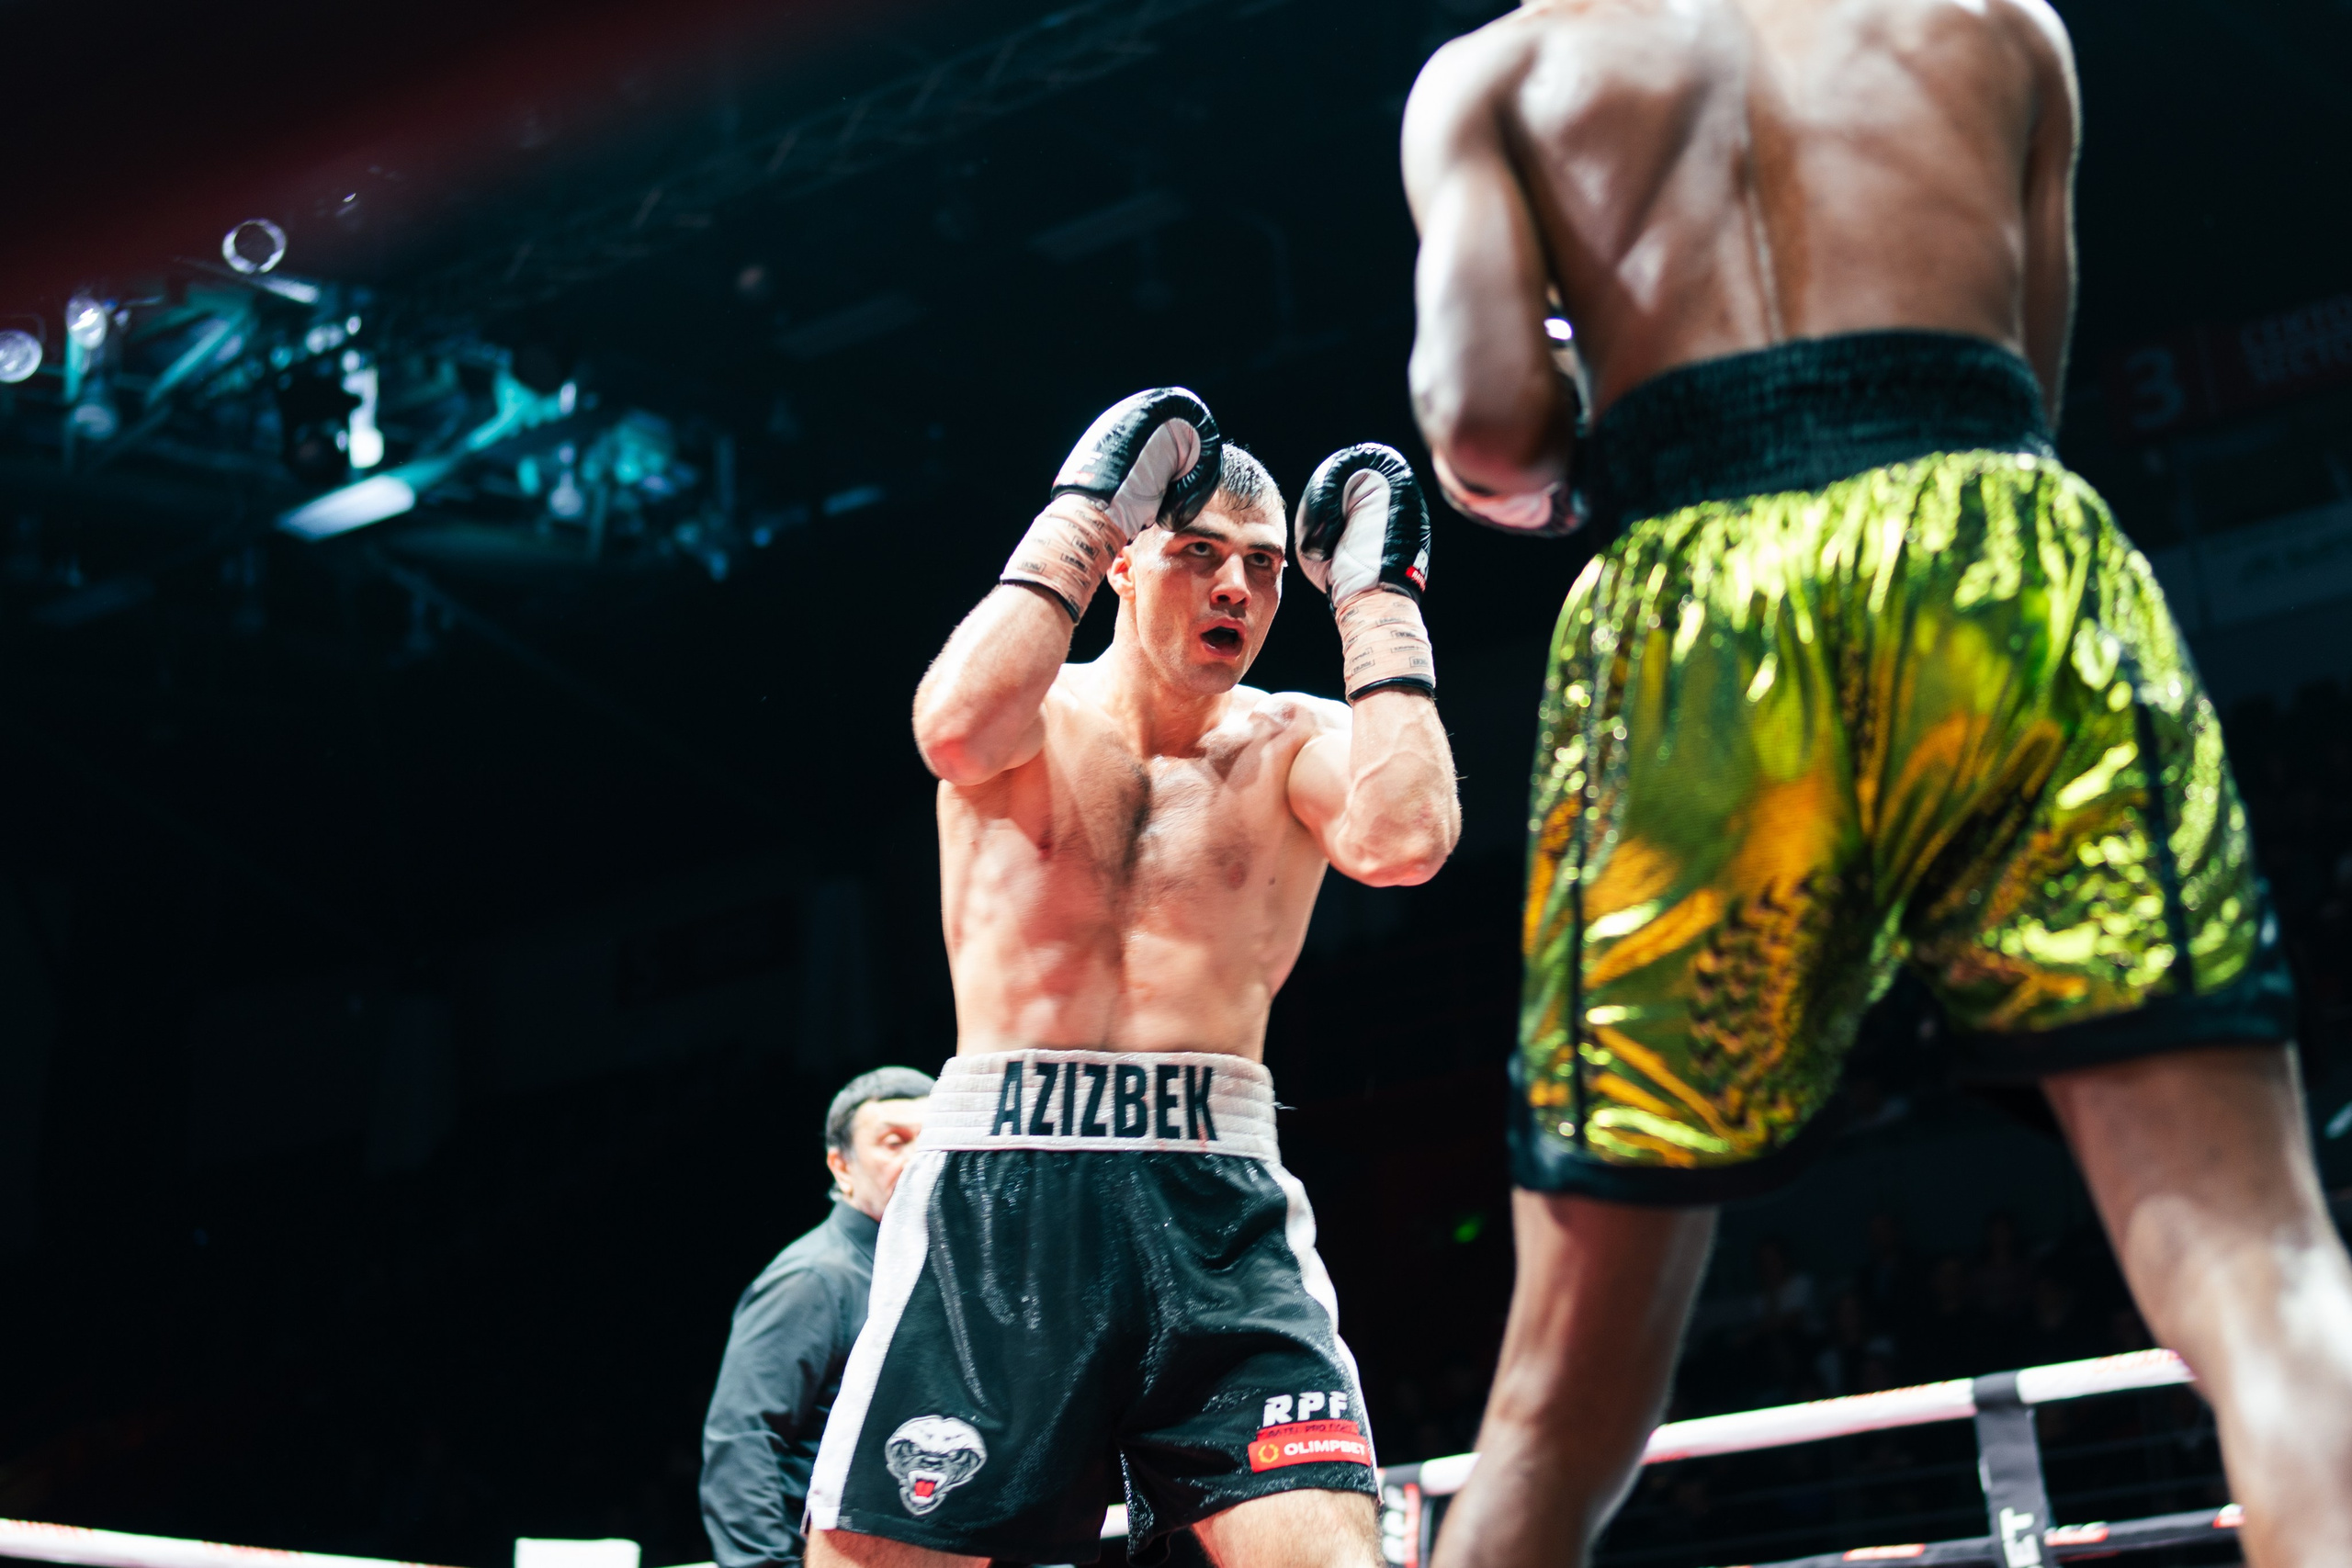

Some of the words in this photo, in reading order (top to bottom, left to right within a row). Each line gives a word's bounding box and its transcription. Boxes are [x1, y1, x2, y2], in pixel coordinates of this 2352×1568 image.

[2123, 346, 2186, 429] 3
[990, 1060, 1217, 1141] AZIZBEK
[1262, 1391, 1347, 1427] RPF
[1283, 1439, 1365, 1456] OLIMPBET
[1999, 1507, 2045, 1568] ET
